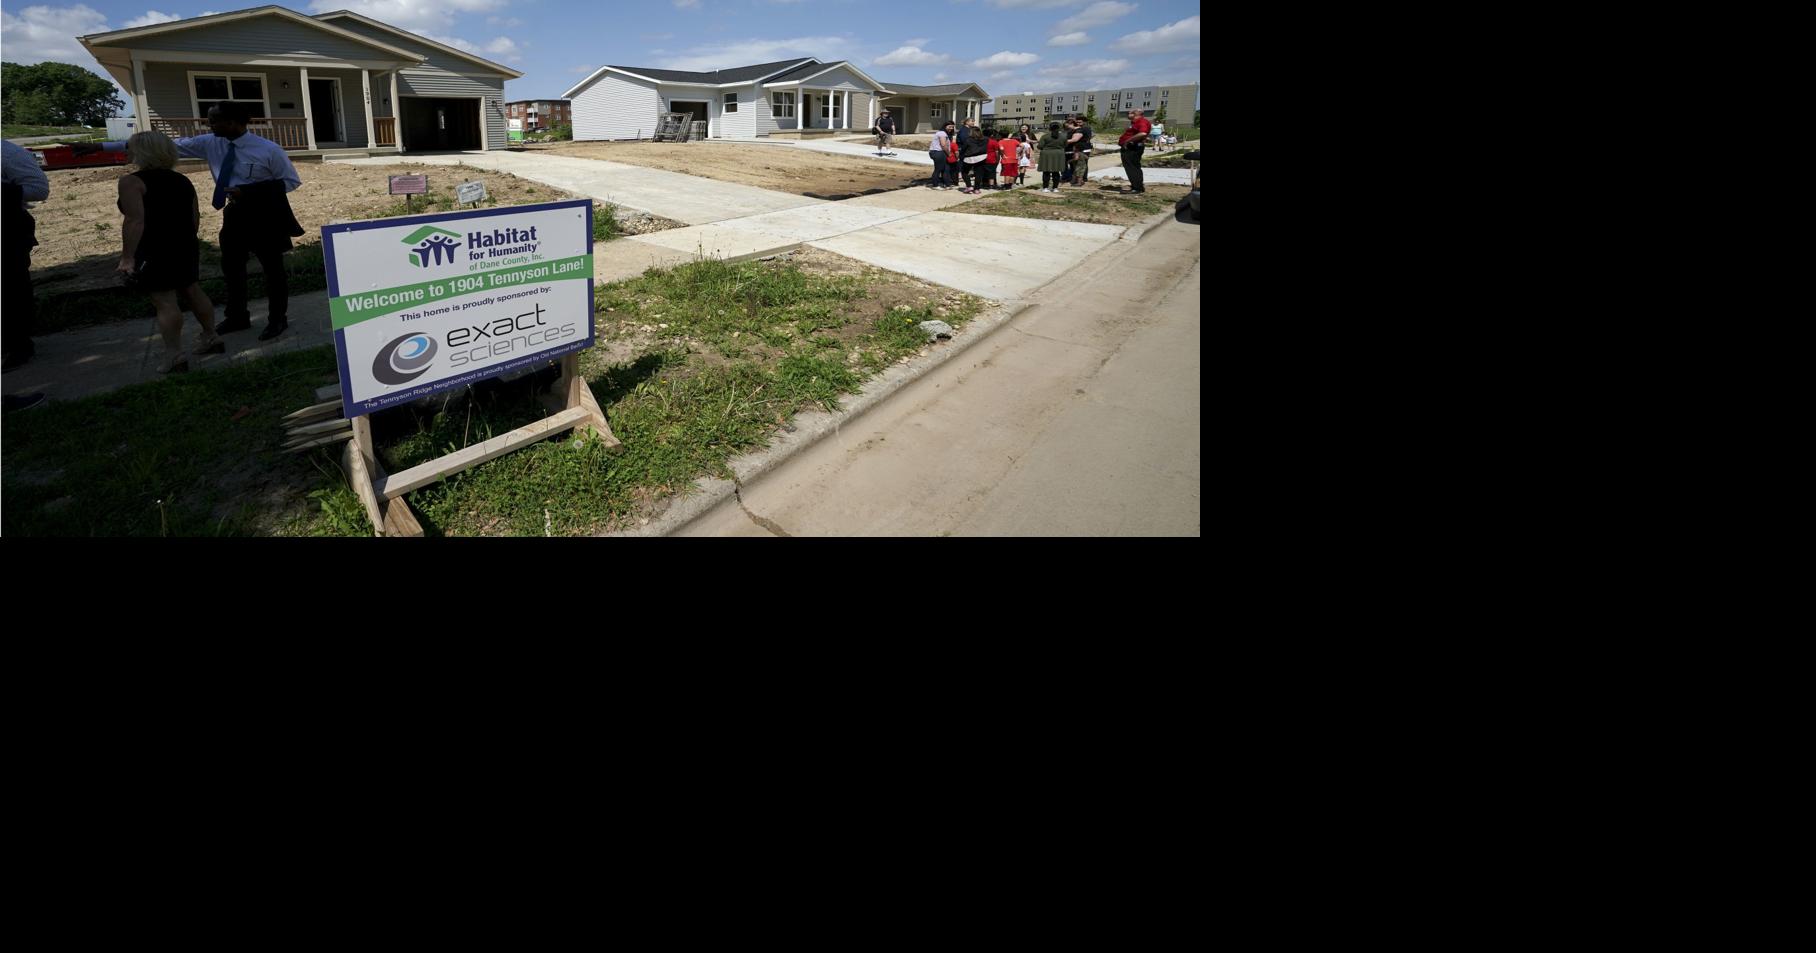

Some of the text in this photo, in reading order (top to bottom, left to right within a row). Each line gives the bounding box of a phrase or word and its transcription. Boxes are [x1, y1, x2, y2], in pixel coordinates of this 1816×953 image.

[468, 226, 537, 249] Habitat
[469, 251, 485, 260] for
[469, 262, 479, 271] of
[480, 260, 500, 269] Dane
[502, 256, 530, 266] County,
[346, 258, 584, 312] Welcome to 1904 Tennyson Lane!
[400, 312, 421, 321] This
[424, 306, 450, 316] home
[453, 303, 460, 311] is
[462, 297, 495, 310] proudly
[497, 287, 538, 302] sponsored
[447, 303, 546, 347] exact
[449, 322, 576, 368] sciences
[364, 401, 377, 409] The
[380, 393, 411, 405] Tennyson
[413, 386, 433, 396] Ridge
[434, 373, 476, 389] Neighborhood
[483, 366, 504, 376] proudly
[505, 358, 532, 369] sponsored
[550, 346, 569, 355] National
